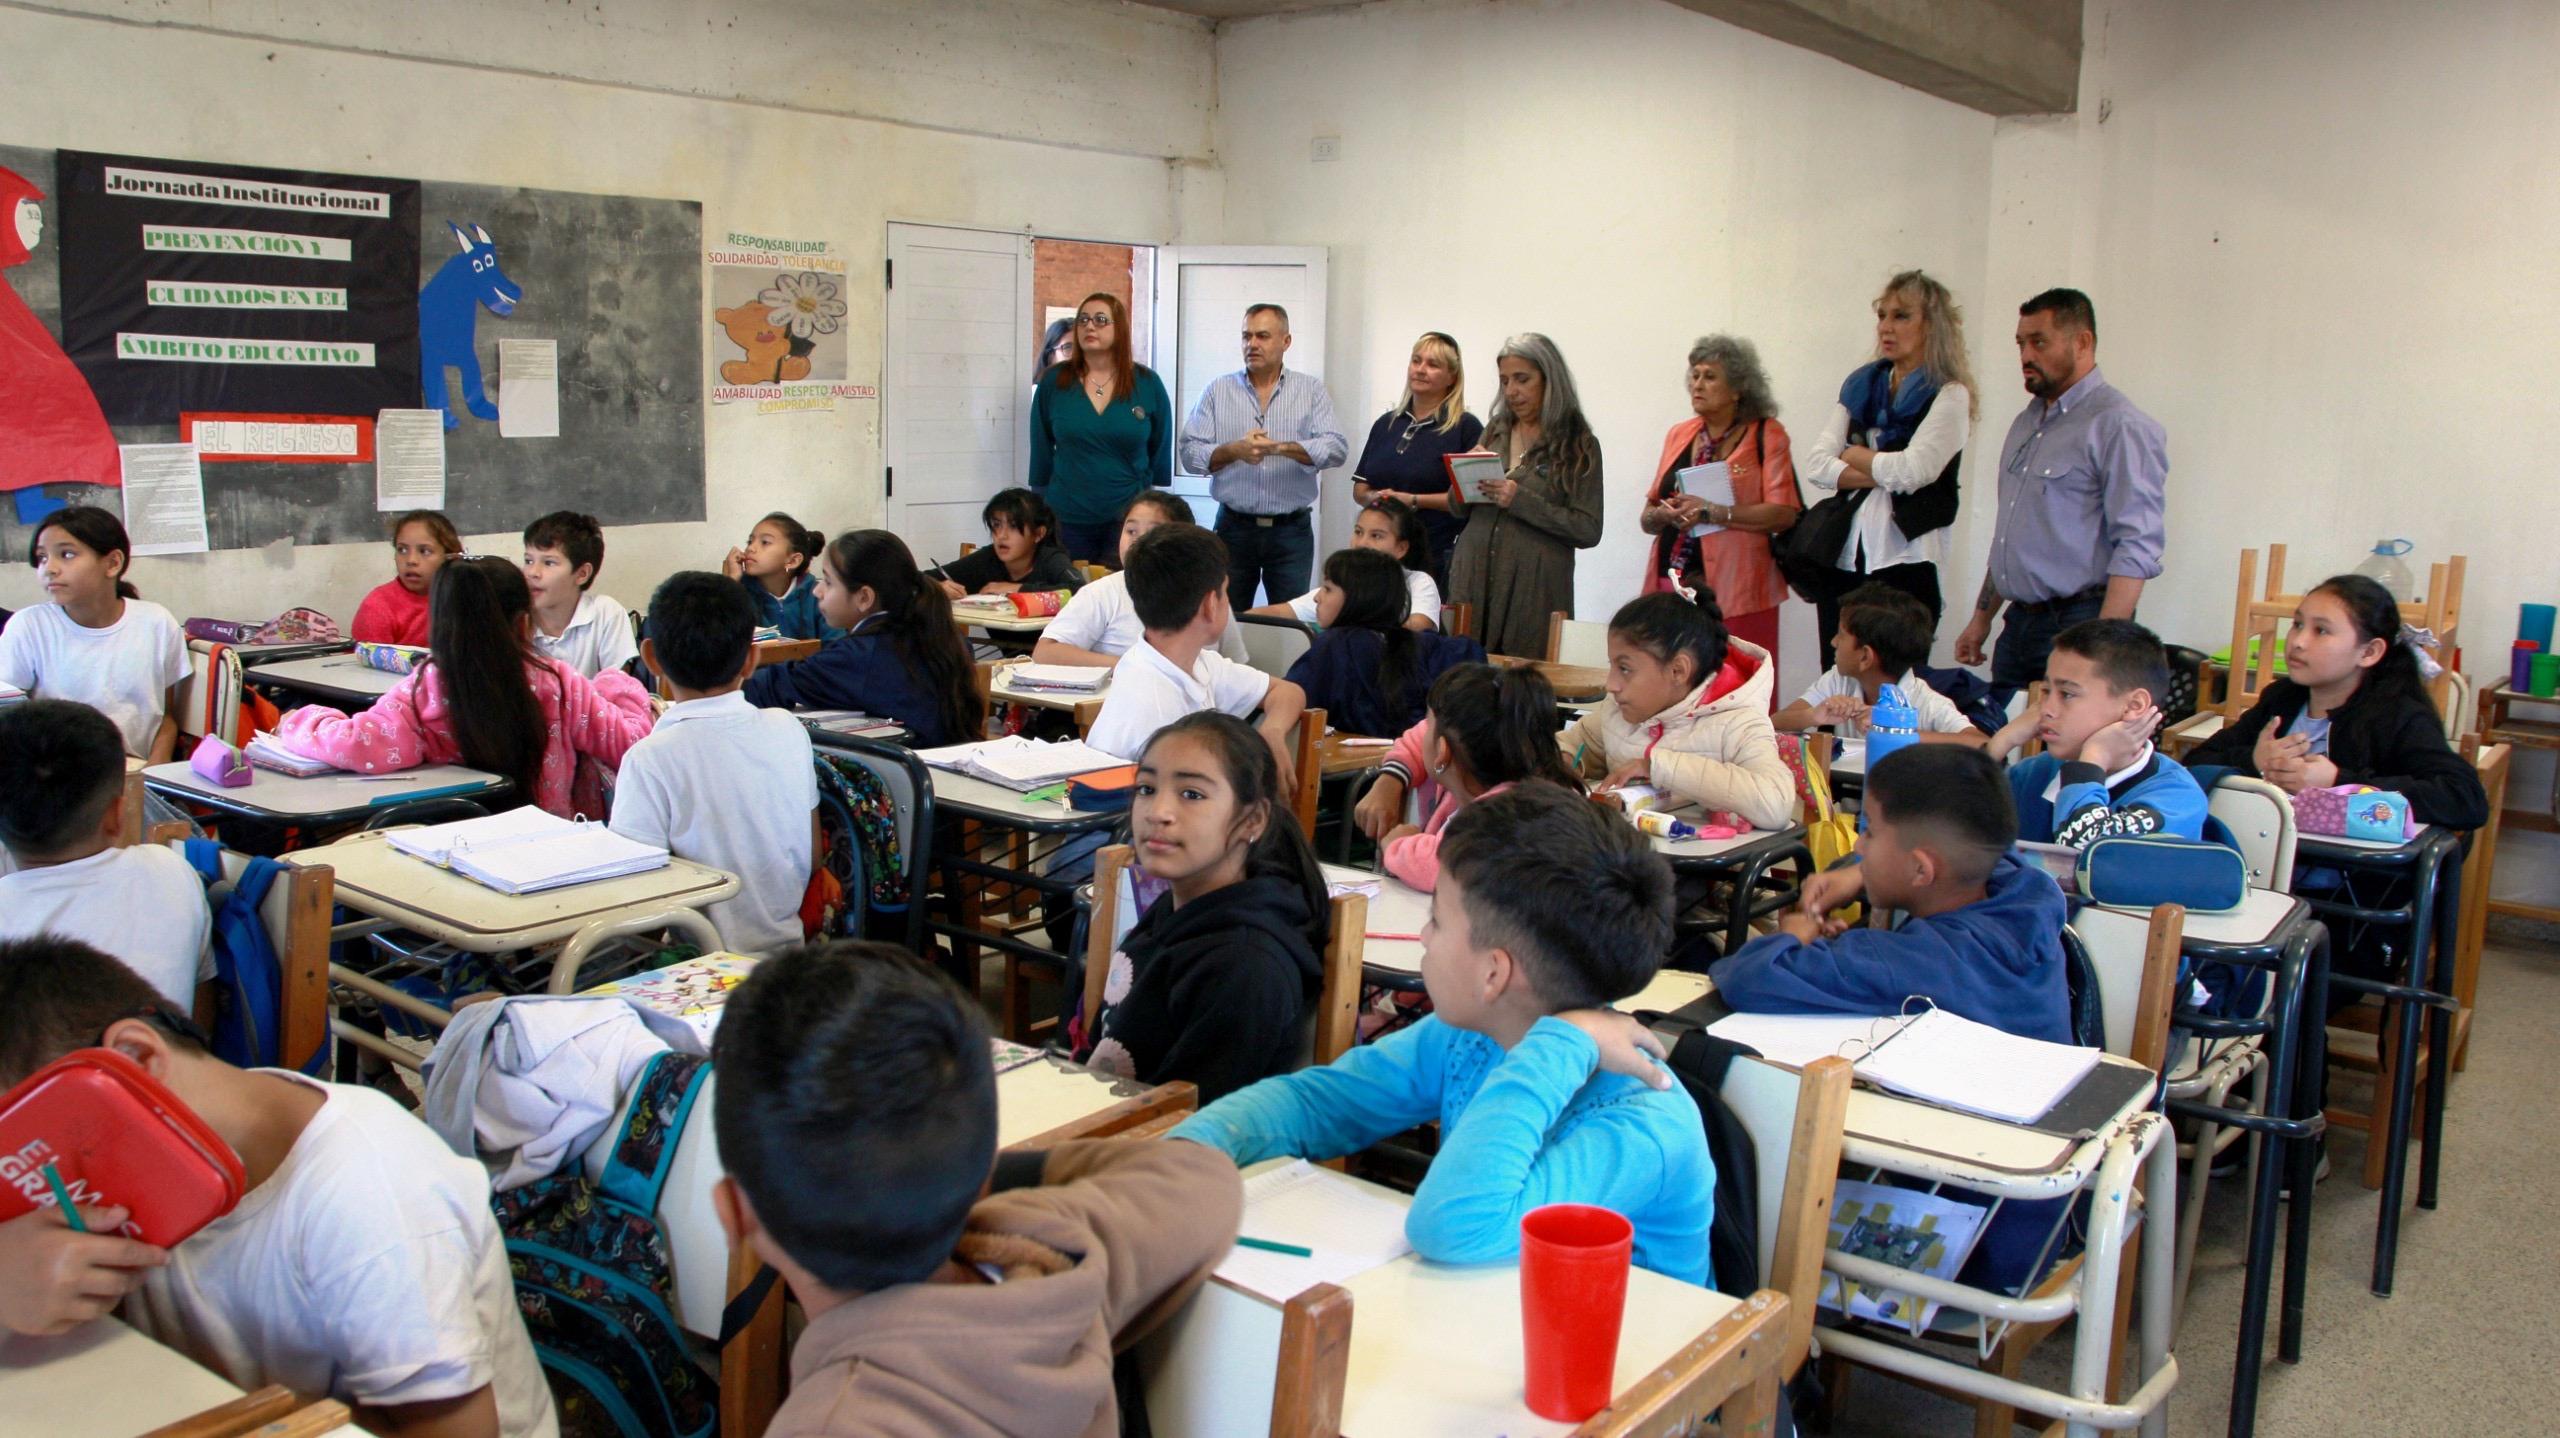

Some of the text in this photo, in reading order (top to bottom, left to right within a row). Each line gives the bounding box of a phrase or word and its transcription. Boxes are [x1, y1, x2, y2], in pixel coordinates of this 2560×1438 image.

[107, 174, 380, 211] Jornada Institucional
[310, 241, 321, 256] Y
[728, 233, 826, 253] RESPONSABILIDAD
[708, 252, 847, 272] SOLIDARIDAD TOLERANCIA
[149, 287, 346, 306] CUIDADOS EN EL
[121, 335, 361, 363] ÁMBITO EDUCATIVO
[713, 385, 876, 399] AMABILIDAD RESPETO AMISTAD
[758, 398, 835, 413] COMPROMISO
[201, 422, 355, 452] EL REGRESO
